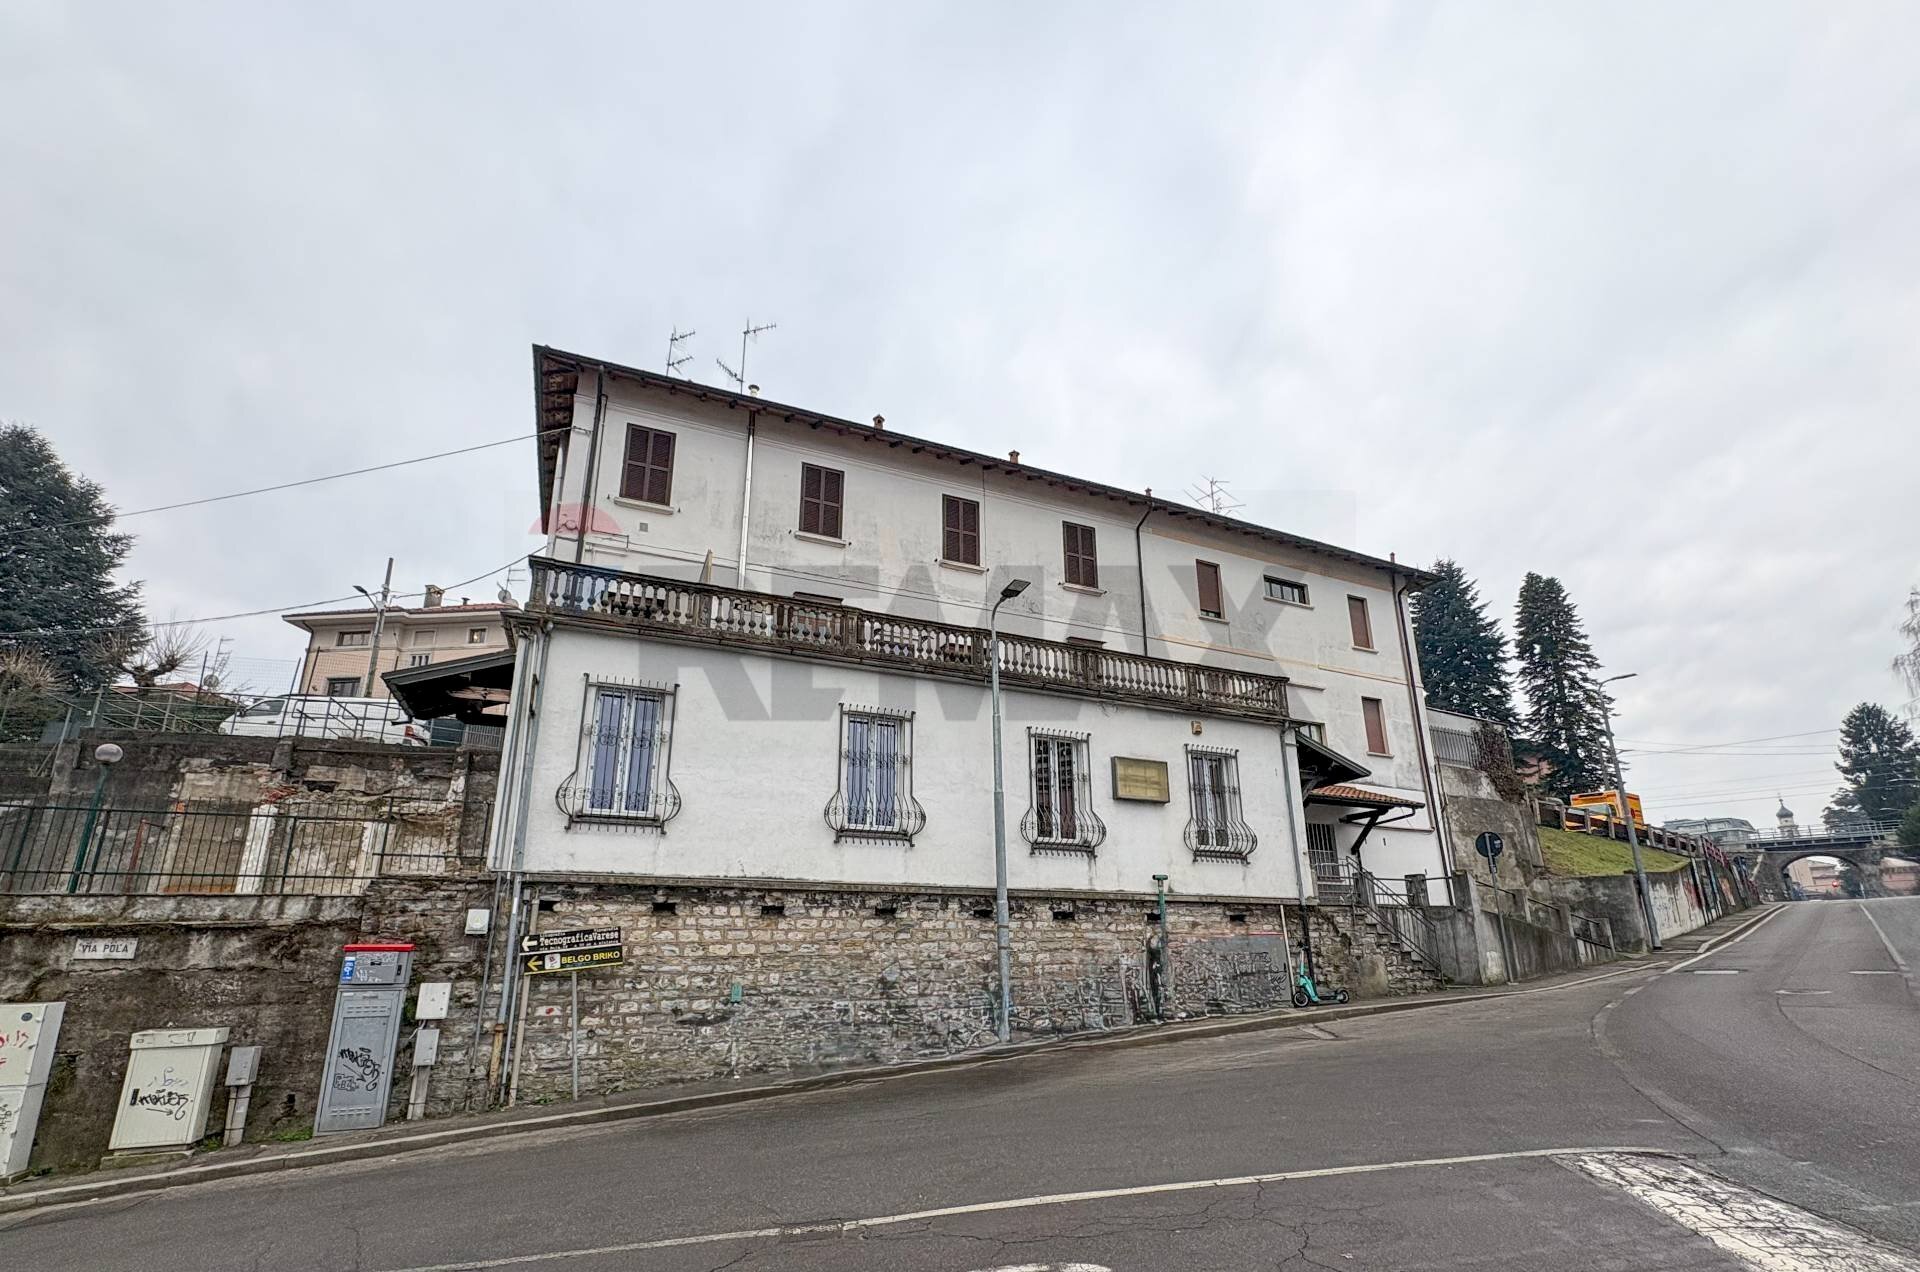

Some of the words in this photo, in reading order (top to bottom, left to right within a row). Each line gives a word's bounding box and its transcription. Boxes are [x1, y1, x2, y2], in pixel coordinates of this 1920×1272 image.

[82, 944, 97, 953] VIA
[103, 944, 128, 953] POLA
[561, 954, 591, 964] BELGO
[592, 951, 620, 961] BRIKO
